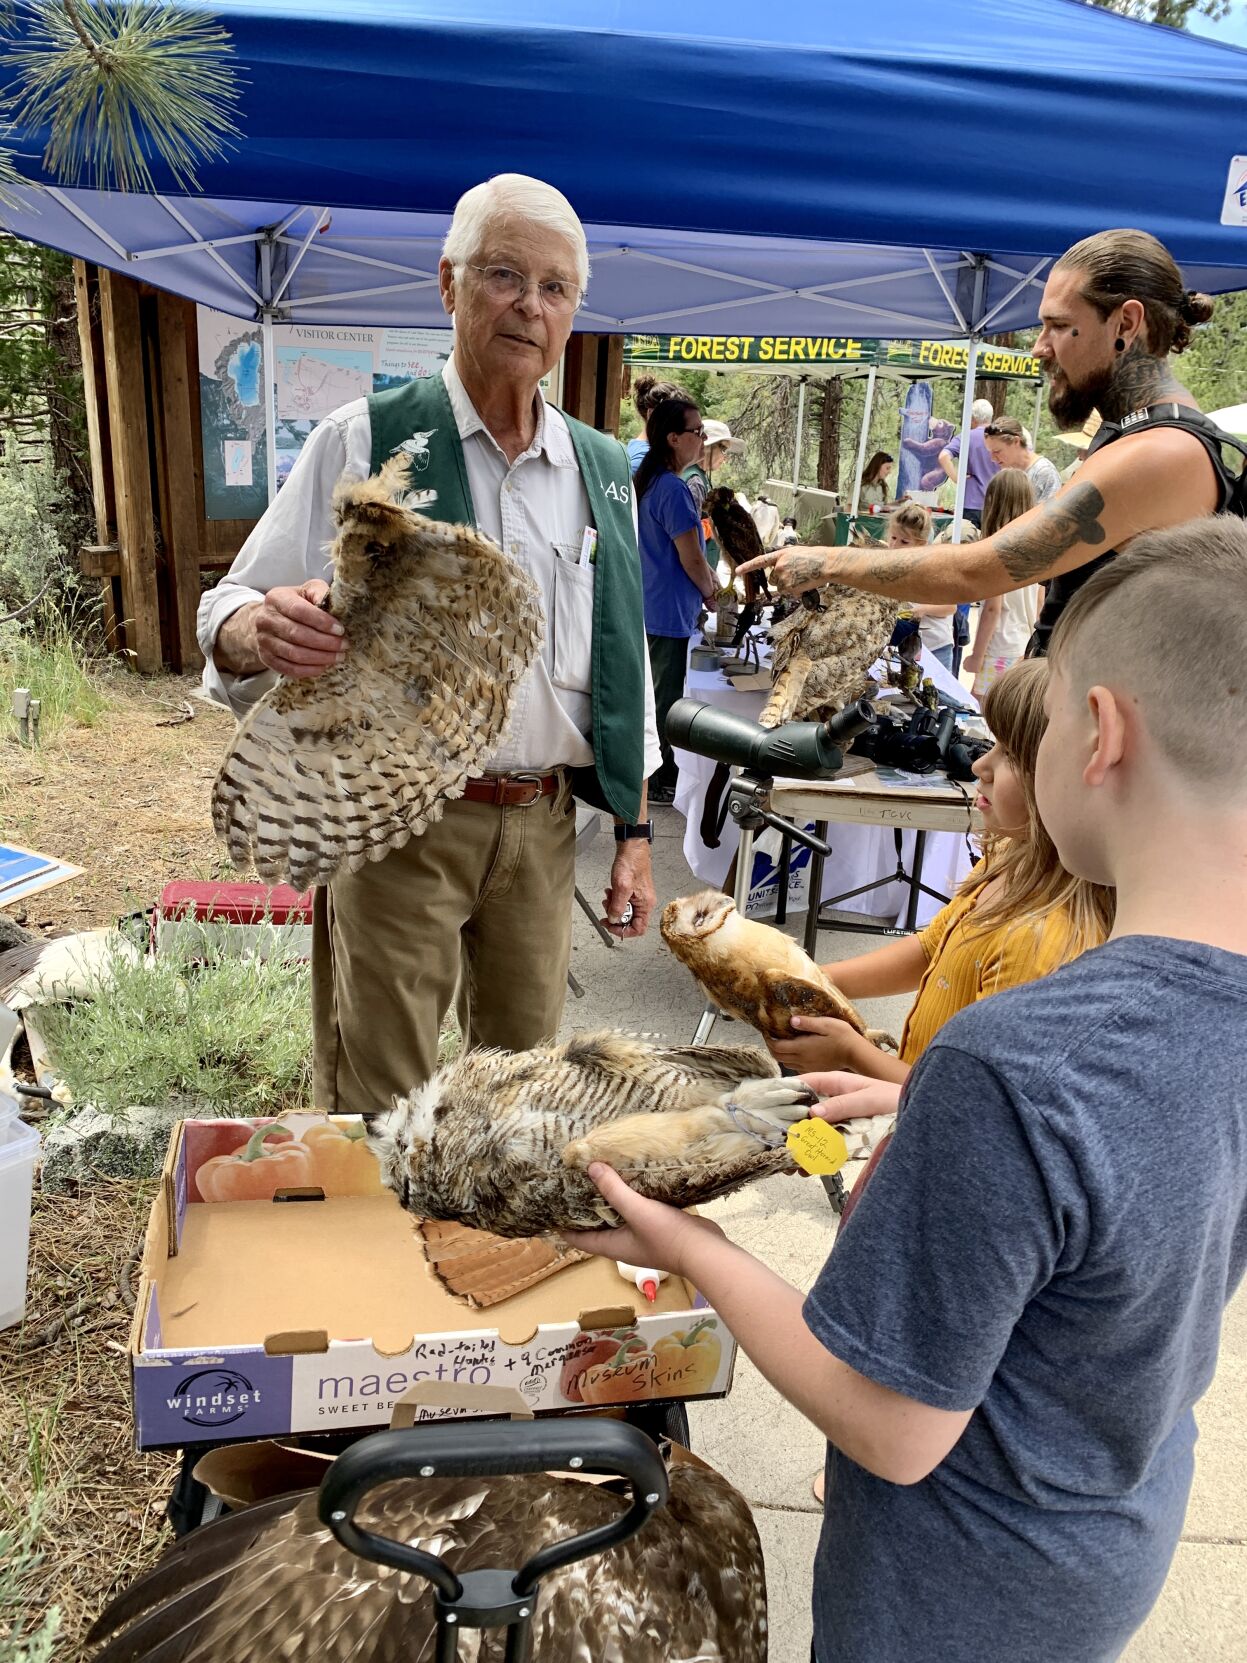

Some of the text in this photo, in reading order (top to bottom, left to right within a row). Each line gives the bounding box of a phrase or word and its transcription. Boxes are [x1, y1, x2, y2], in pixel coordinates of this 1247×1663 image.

[296, 328, 335, 341] VISITOR
[336, 331, 374, 343] CENTER
[668, 336, 862, 361] FOREST SERVICE
[982, 351, 1041, 376] SERVICE
[566, 1354, 658, 1395] Museum
[166, 1390, 261, 1409] windset
[318, 1403, 369, 1415] SWEET
